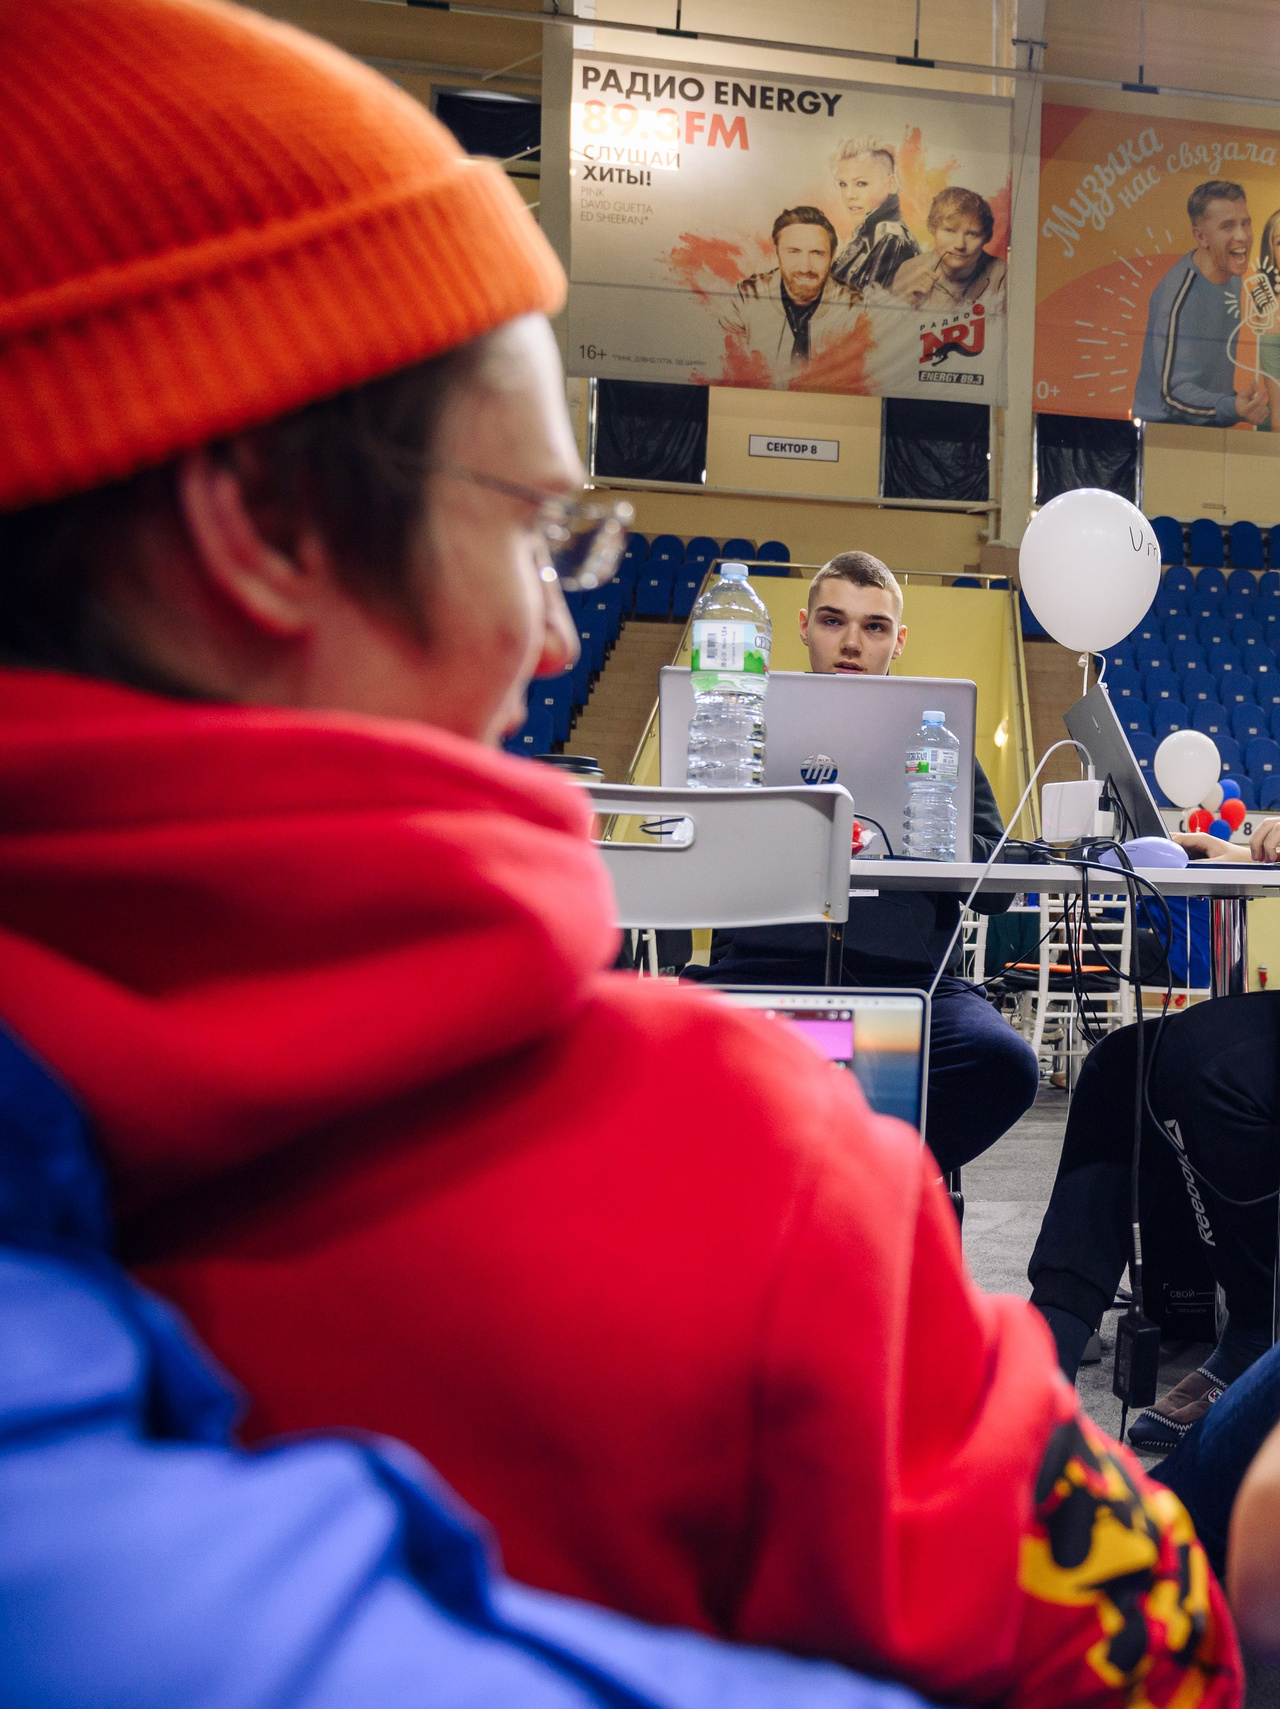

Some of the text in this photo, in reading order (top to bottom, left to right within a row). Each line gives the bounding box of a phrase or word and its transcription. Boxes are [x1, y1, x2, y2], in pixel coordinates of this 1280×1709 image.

[582, 66, 843, 117] РАДИО ENERGY
[582, 165, 652, 187] ХИТЫ!
[1118, 141, 1277, 209] нас связала
[580, 186, 605, 197] PINK
[1042, 127, 1164, 259] Музыка
[580, 199, 654, 215] DAVID GUETTA
[580, 211, 594, 222] ED
[920, 312, 970, 331] РАДИО
[579, 344, 608, 360] 16+
[920, 371, 983, 384] ENERGY 89.3
[1036, 380, 1061, 399] 0+
[766, 442, 818, 454] СЕКТОР 8
[1243, 822, 1252, 836] 8
[1177, 1154, 1216, 1247] Reebok
[1170, 1289, 1195, 1298] СВОЙ
